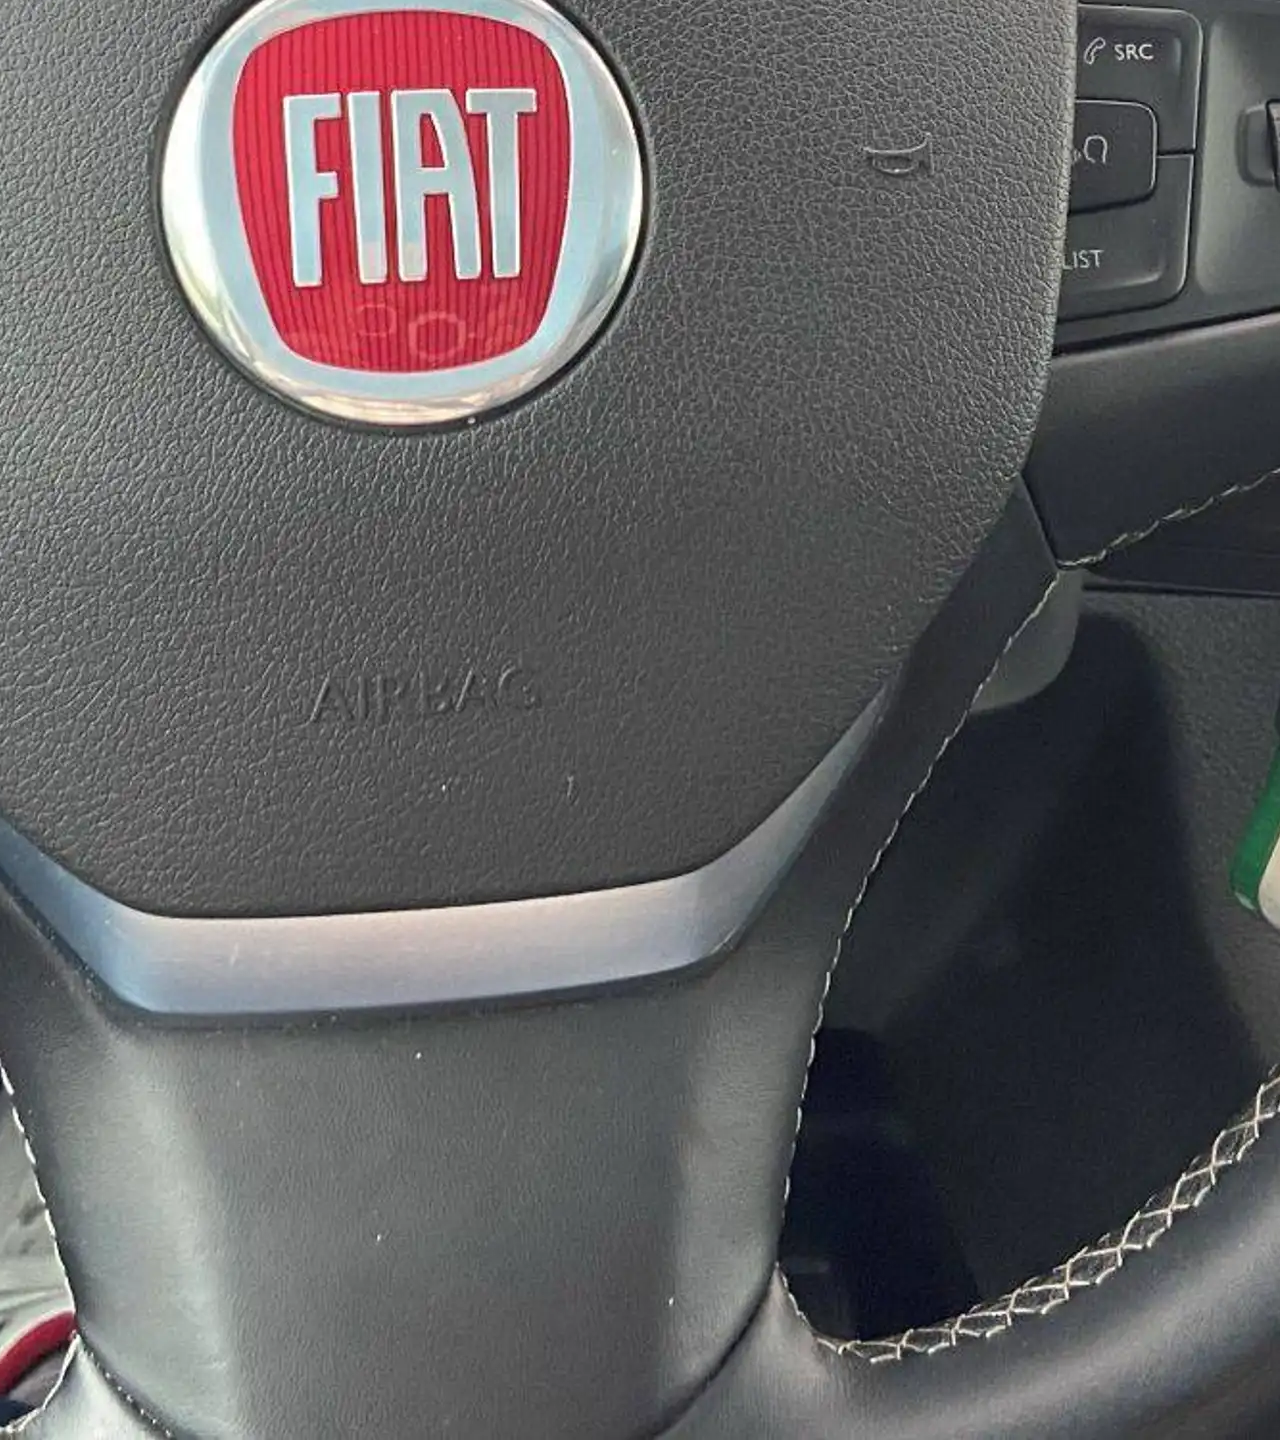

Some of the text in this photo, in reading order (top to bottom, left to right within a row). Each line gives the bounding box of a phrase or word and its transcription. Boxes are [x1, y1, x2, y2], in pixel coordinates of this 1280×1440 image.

[1114, 43, 1153, 61] SRC
[282, 87, 537, 288] FIAT
[1063, 249, 1104, 270] LIST
